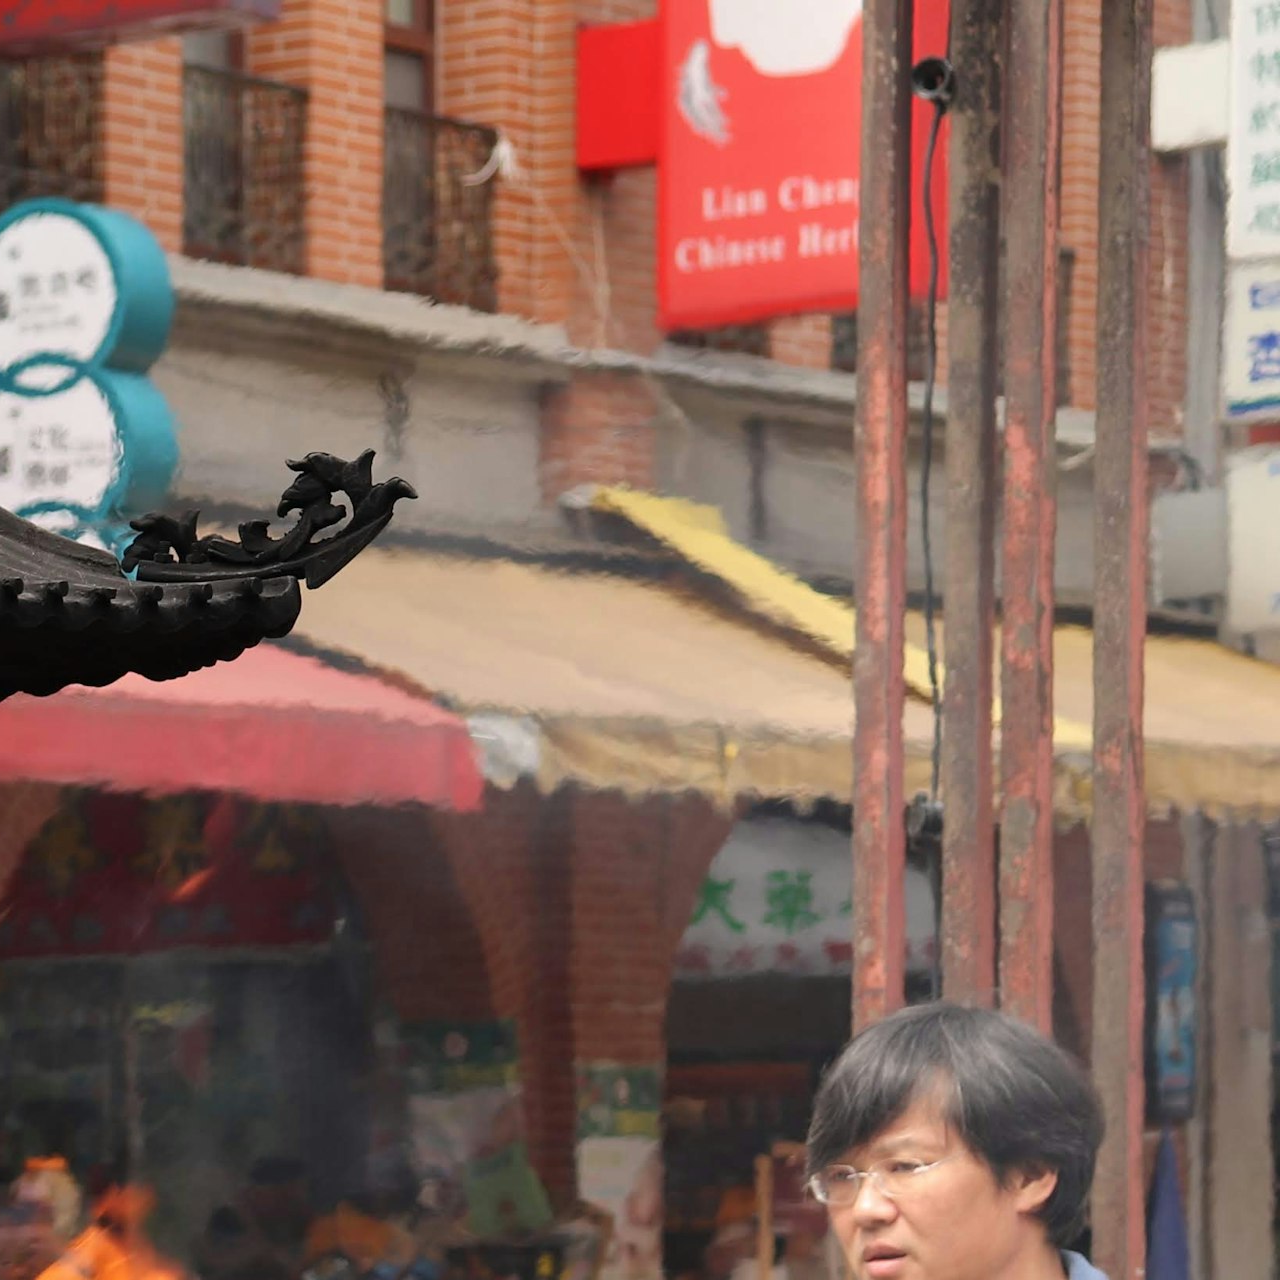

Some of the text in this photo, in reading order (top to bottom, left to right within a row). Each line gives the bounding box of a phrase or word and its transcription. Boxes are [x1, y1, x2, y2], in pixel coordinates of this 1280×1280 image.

[702, 174, 860, 222] Lian Chen
[675, 235, 785, 273] Chinese
